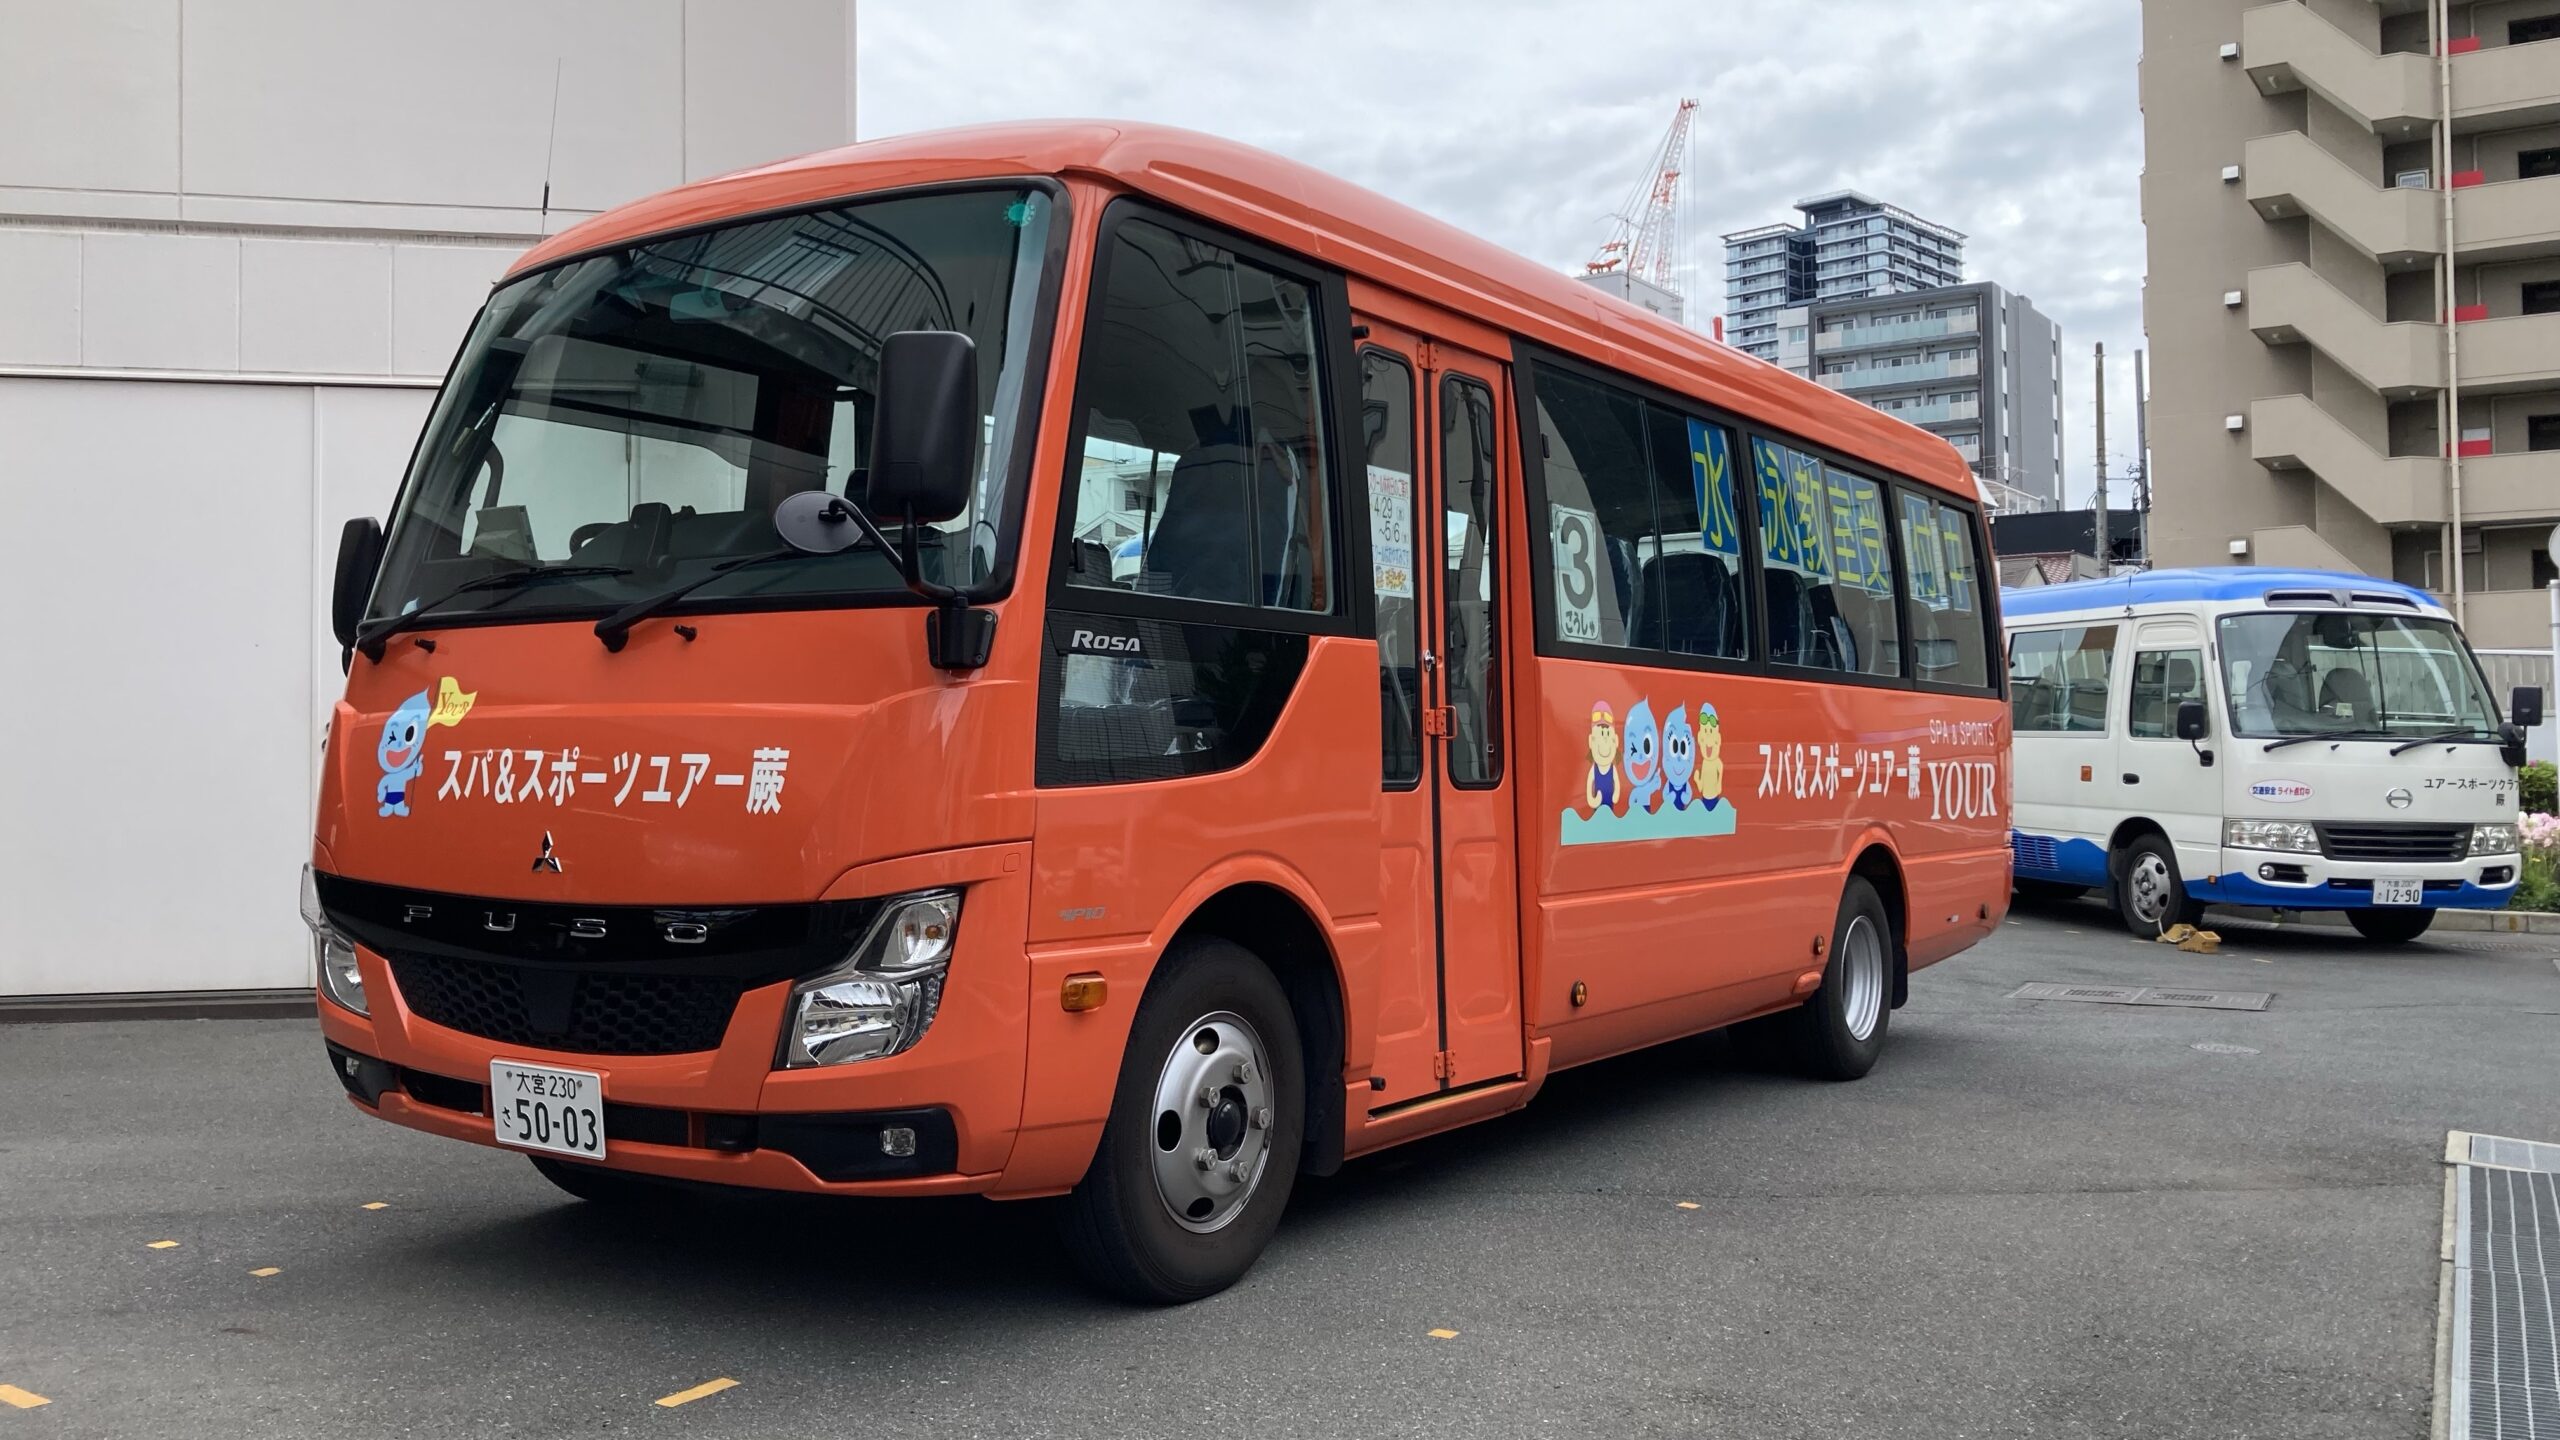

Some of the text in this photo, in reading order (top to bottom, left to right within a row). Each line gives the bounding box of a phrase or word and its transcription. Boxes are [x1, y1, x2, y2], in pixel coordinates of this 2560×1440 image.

[1561, 516, 1594, 610] 3
[1930, 719, 1949, 744] SPA
[1960, 721, 1995, 747] SPORTS
[1927, 761, 1998, 820] YOUR
[2385, 889, 2420, 903] 12-90
[403, 904, 708, 944] FUSO
[502, 1098, 598, 1152] さ 50-03
